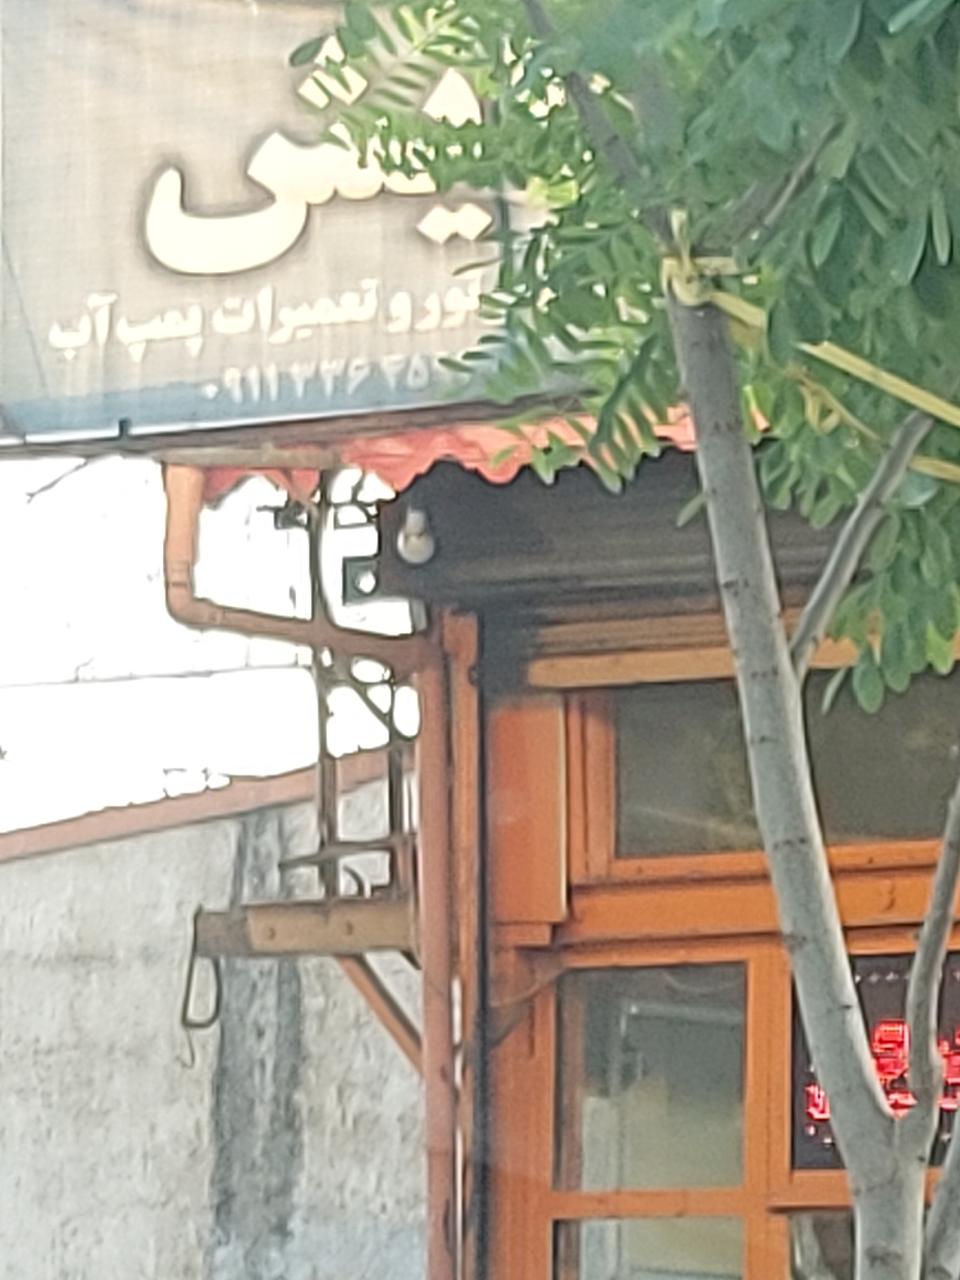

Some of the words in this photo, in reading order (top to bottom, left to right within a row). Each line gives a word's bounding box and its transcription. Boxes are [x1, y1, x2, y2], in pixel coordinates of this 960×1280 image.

[48, 291, 118, 361] آب
[116, 304, 204, 363] پمپ
[212, 278, 378, 346] تعمیرات
[386, 291, 412, 334] و
